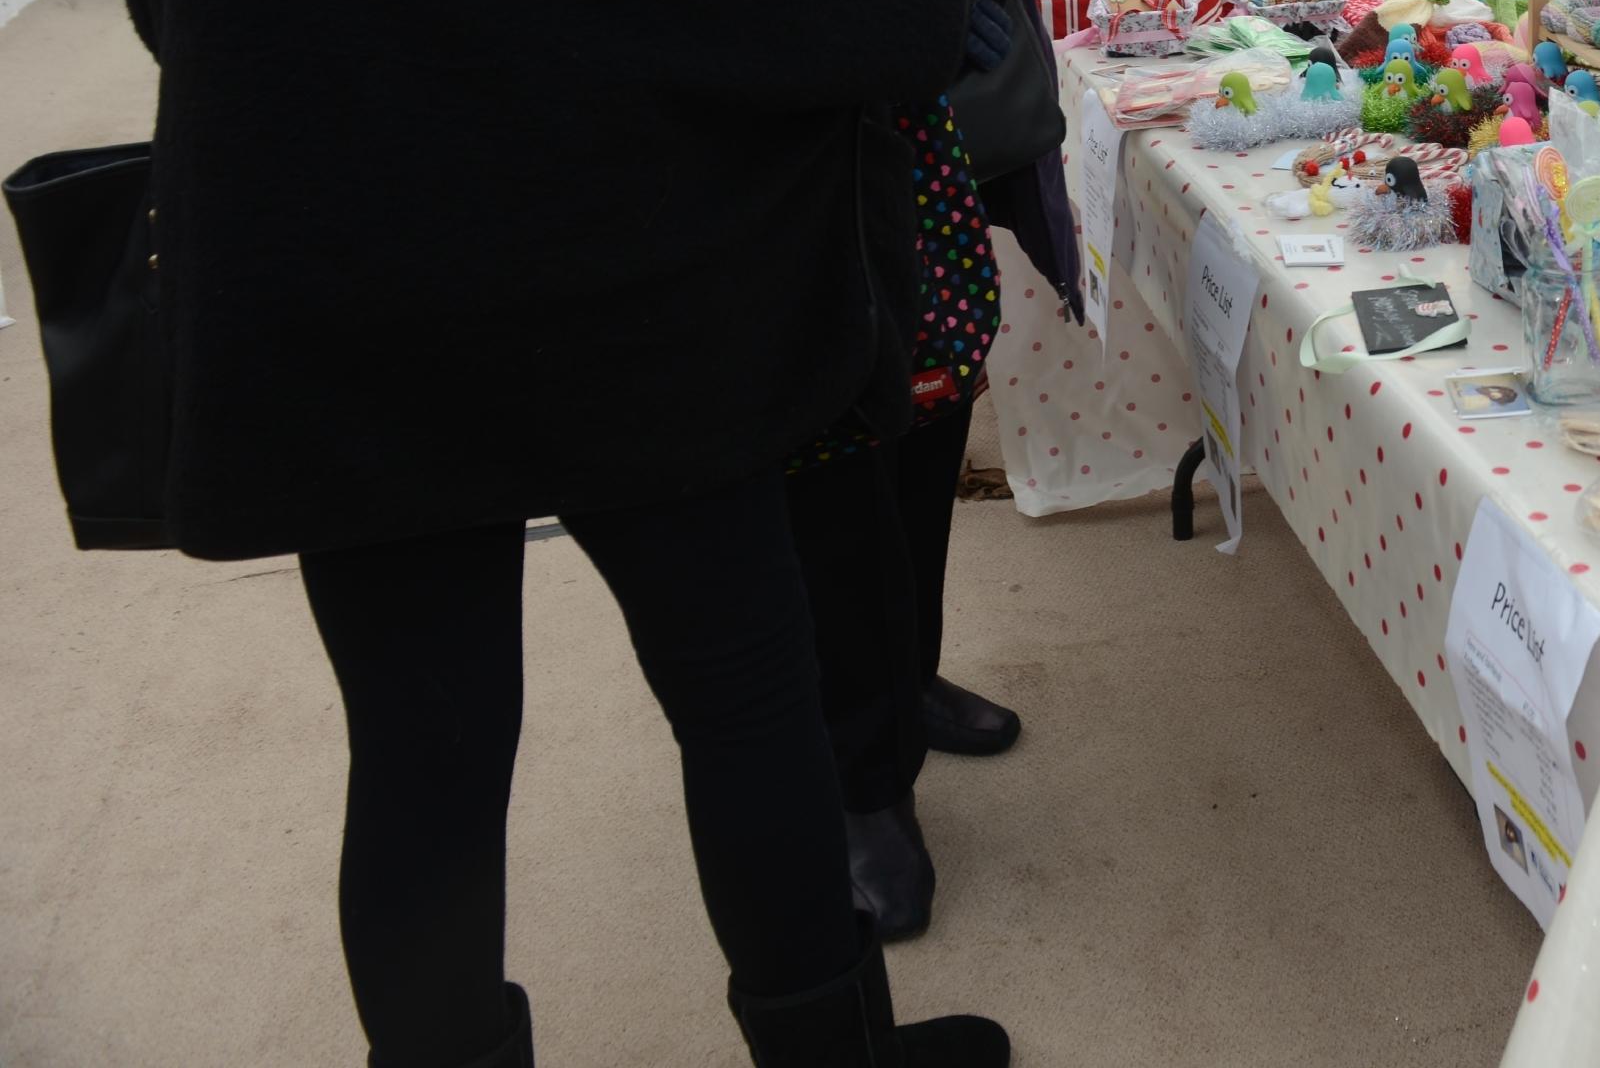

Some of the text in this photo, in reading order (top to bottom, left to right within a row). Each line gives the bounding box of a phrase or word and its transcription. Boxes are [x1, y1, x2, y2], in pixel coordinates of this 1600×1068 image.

[1201, 265, 1232, 319] Price List
[1491, 582, 1545, 663] Price List
